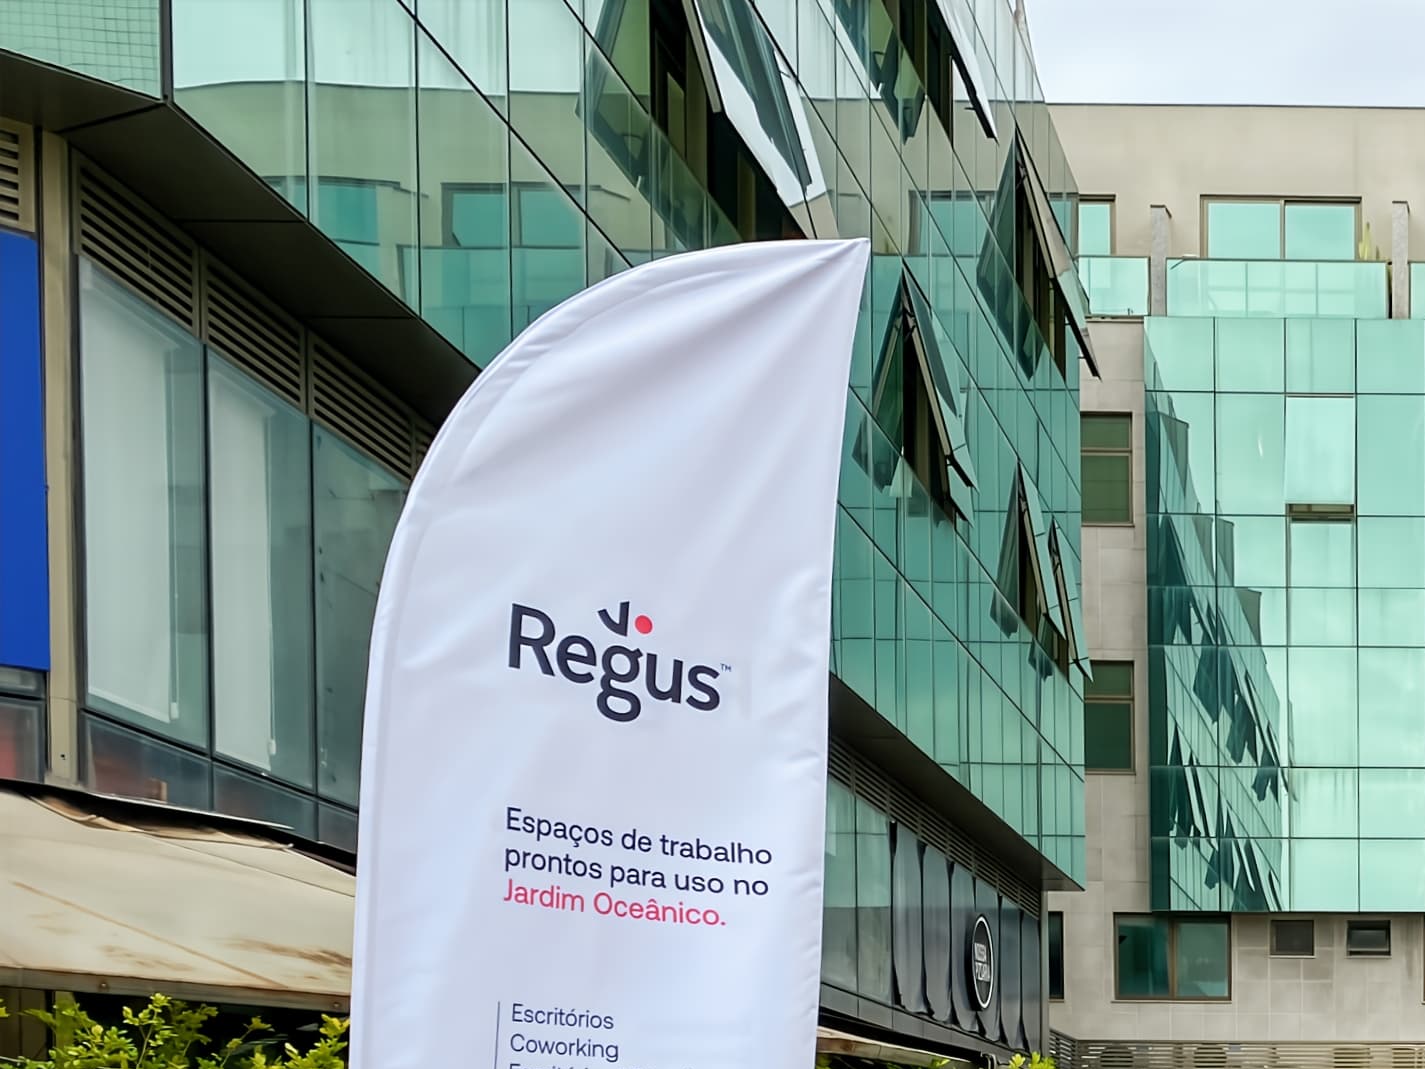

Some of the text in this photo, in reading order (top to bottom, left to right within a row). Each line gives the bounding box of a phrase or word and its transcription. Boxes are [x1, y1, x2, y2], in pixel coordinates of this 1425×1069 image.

[508, 601, 720, 722] Regus
[507, 807, 772, 864] Espaços de trabalho
[505, 848, 768, 895] prontos para uso no
[504, 879, 725, 925] Jardim Oceânico.
[512, 1003, 614, 1029] Escritórios
[510, 1033, 618, 1063] Coworking
